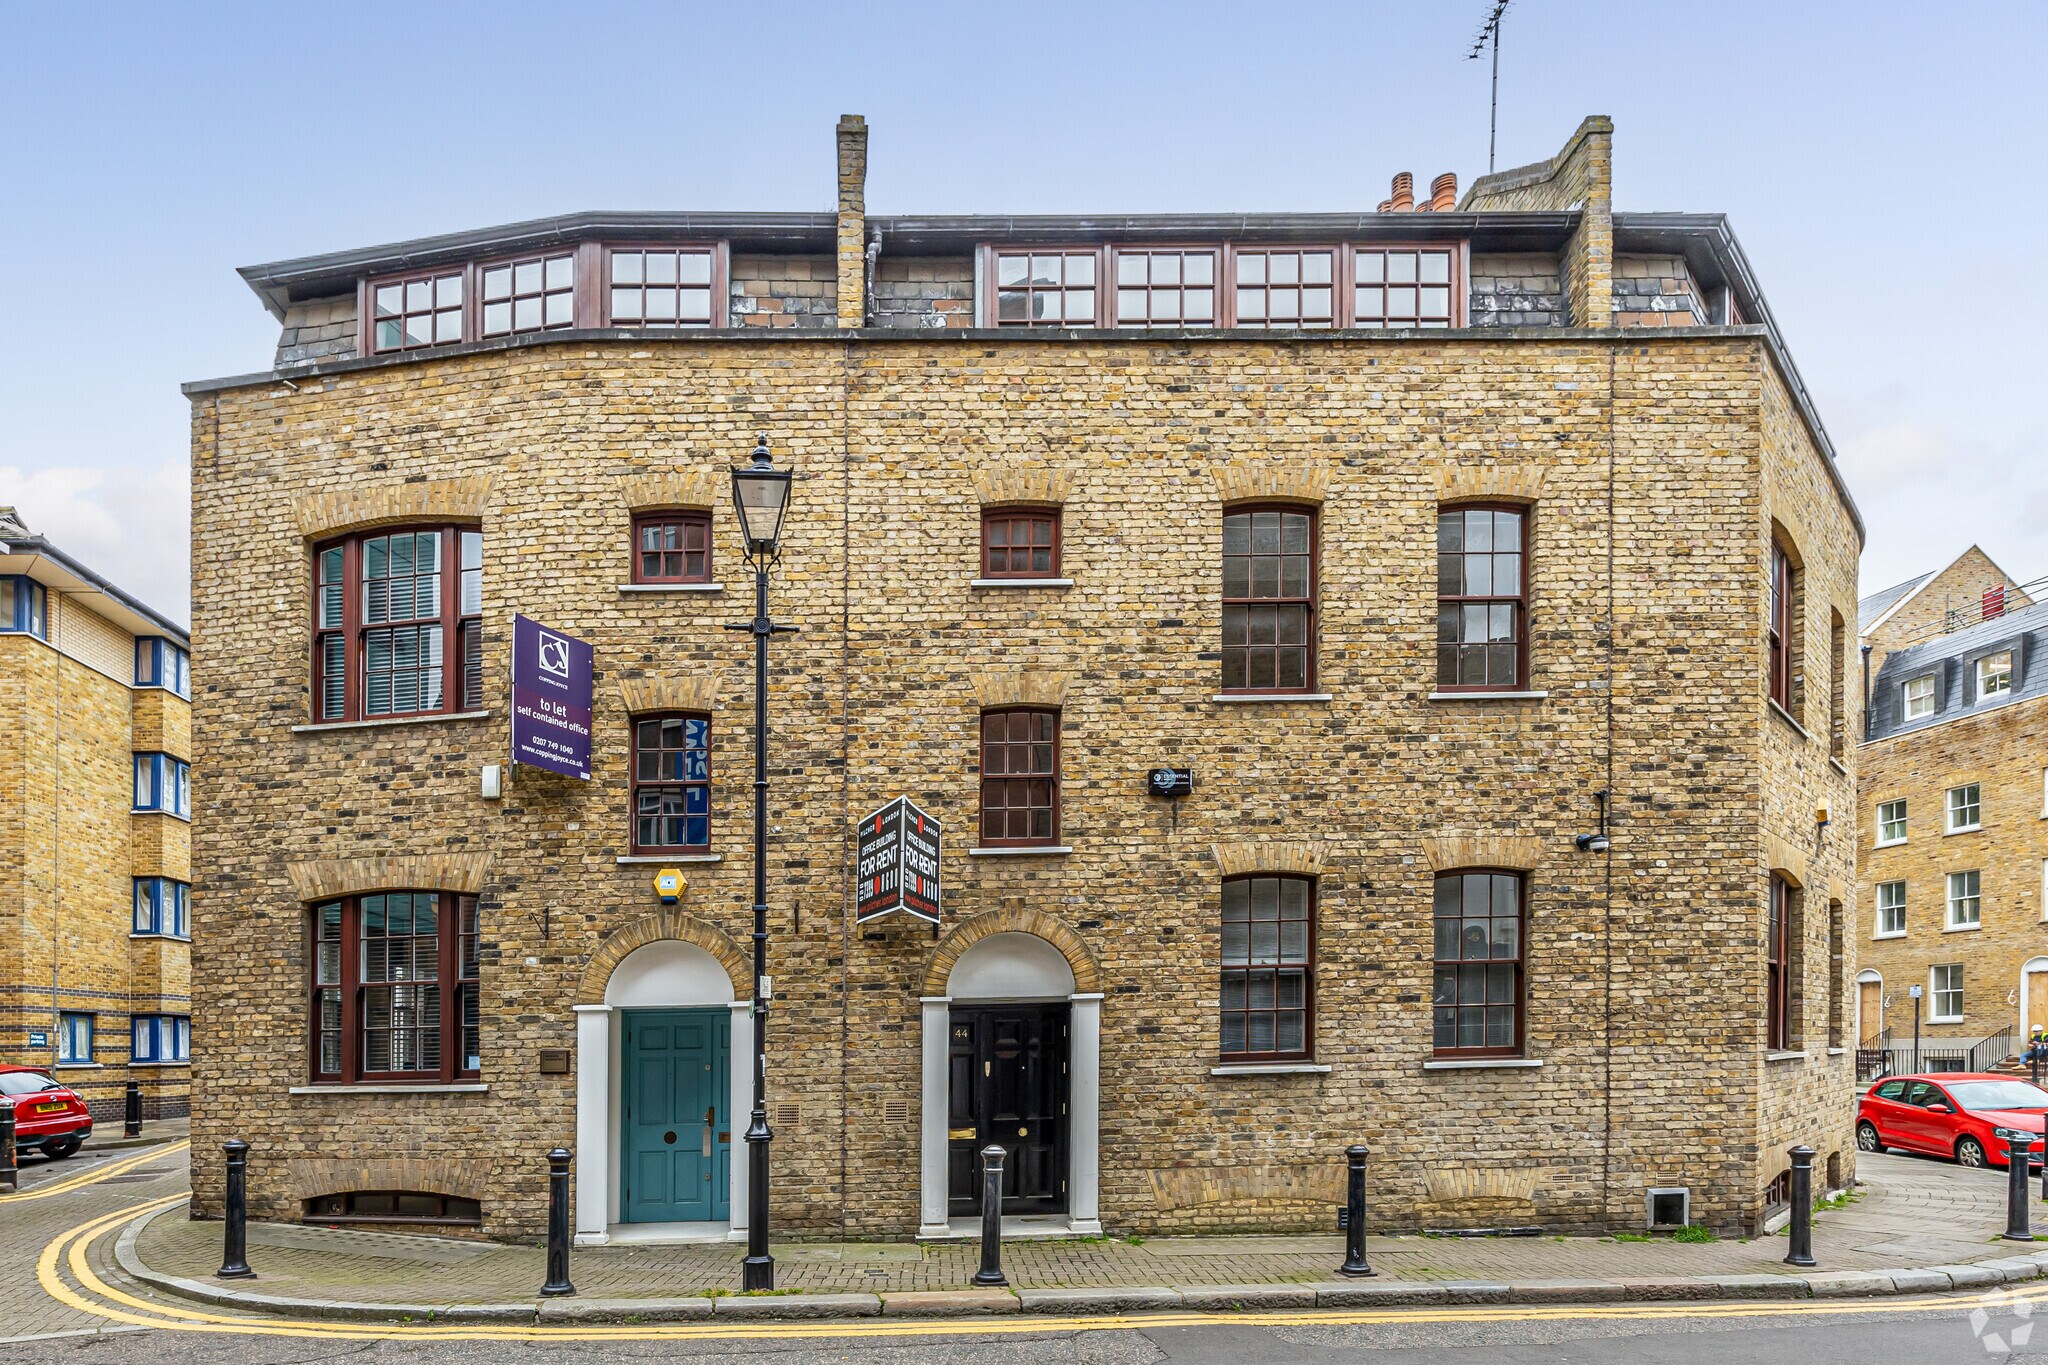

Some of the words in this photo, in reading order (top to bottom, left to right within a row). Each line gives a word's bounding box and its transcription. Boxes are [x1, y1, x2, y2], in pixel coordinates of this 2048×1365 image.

[540, 697, 551, 712] to
[553, 701, 567, 718] let
[517, 705, 532, 717] self
[532, 711, 568, 729] contained
[568, 722, 589, 736] office
[532, 735, 547, 747] 0207
[547, 740, 559, 750] 749
[521, 744, 584, 768] www.coppingjoyce.co.uk
[882, 810, 899, 825] LONDON
[923, 823, 938, 838] LONDON
[862, 841, 876, 856] OFFICE
[876, 830, 897, 849] BUILDING
[906, 830, 919, 847] OFFICE
[918, 838, 936, 857] BUILDING
[860, 856, 875, 879] FOR
[877, 844, 898, 871] RENT
[905, 844, 918, 870] FOR
[918, 853, 938, 879] RENT
[660, 878, 677, 888] ADT
[1884, 995, 1891, 1008] 6
[2007, 989, 2017, 1005] 6
[955, 1029, 968, 1038] 44
